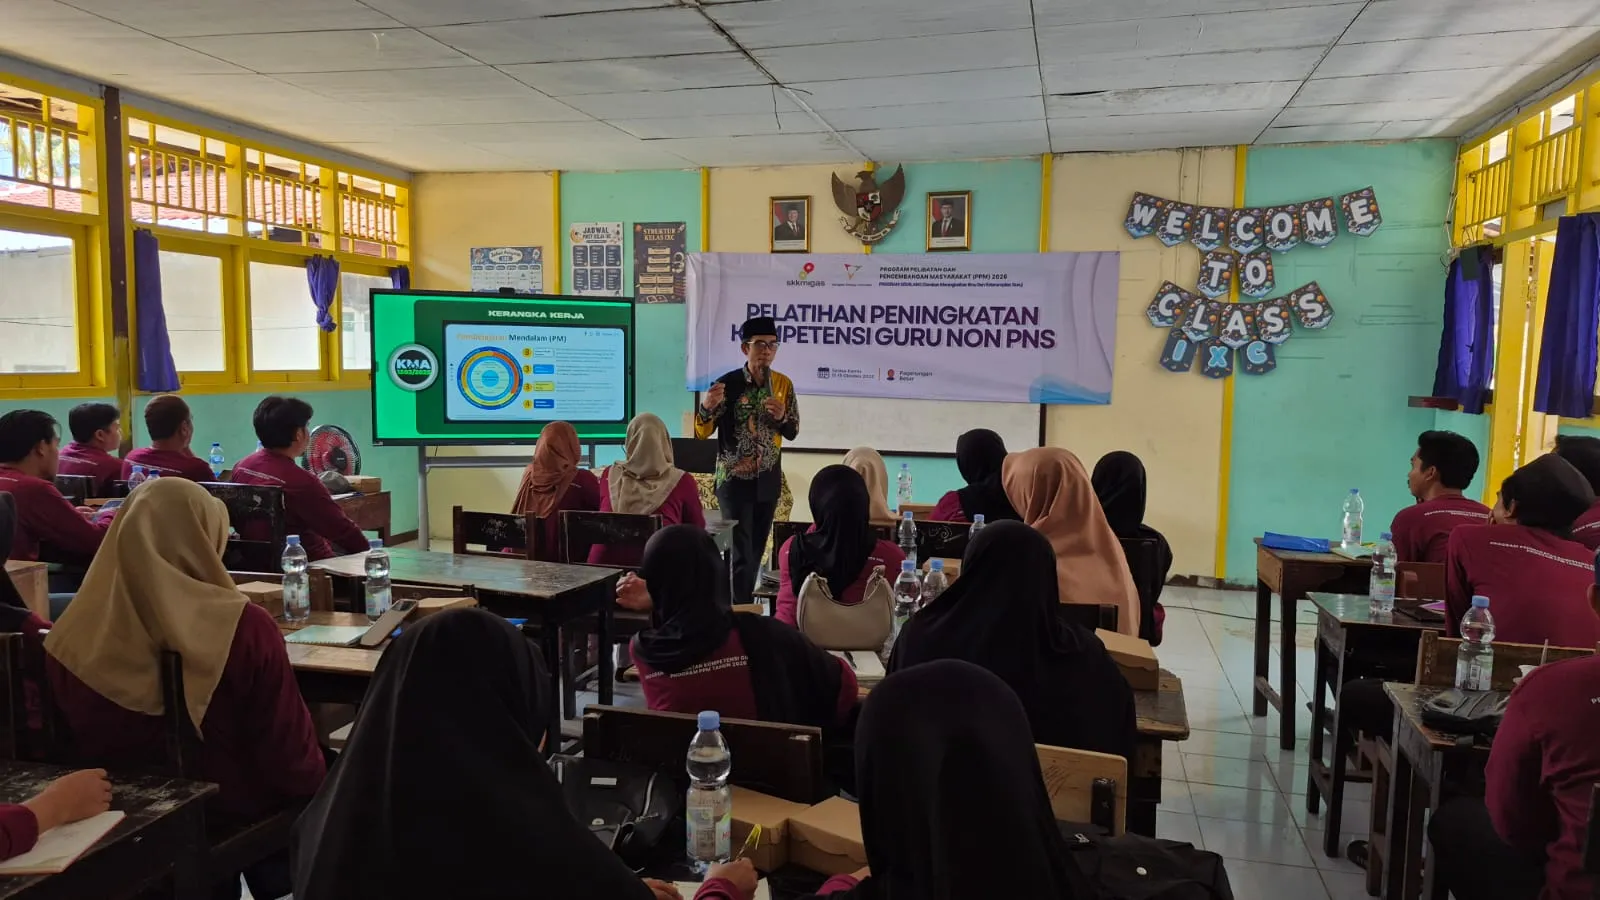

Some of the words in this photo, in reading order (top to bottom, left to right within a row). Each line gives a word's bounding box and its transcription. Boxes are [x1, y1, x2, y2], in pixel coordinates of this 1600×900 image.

[1132, 198, 1374, 240] WELCOME
[972, 273, 991, 281] (PPM)
[1207, 258, 1267, 288] TO
[786, 280, 826, 288] skkmigas
[488, 310, 547, 318] KERANGKA
[549, 312, 585, 320] KERJA
[746, 304, 866, 324] PELATIHAN
[870, 305, 1039, 326] PENINGKATAN
[1158, 292, 1323, 336] CLASS
[508, 334, 548, 342] Mendalam
[549, 335, 567, 343] (PM)
[731, 324, 871, 345] KPETENSI
[875, 327, 941, 347] GURU
[946, 328, 1002, 348] NON
[1006, 329, 1056, 349] PNS
[396, 359, 431, 369] KMA
